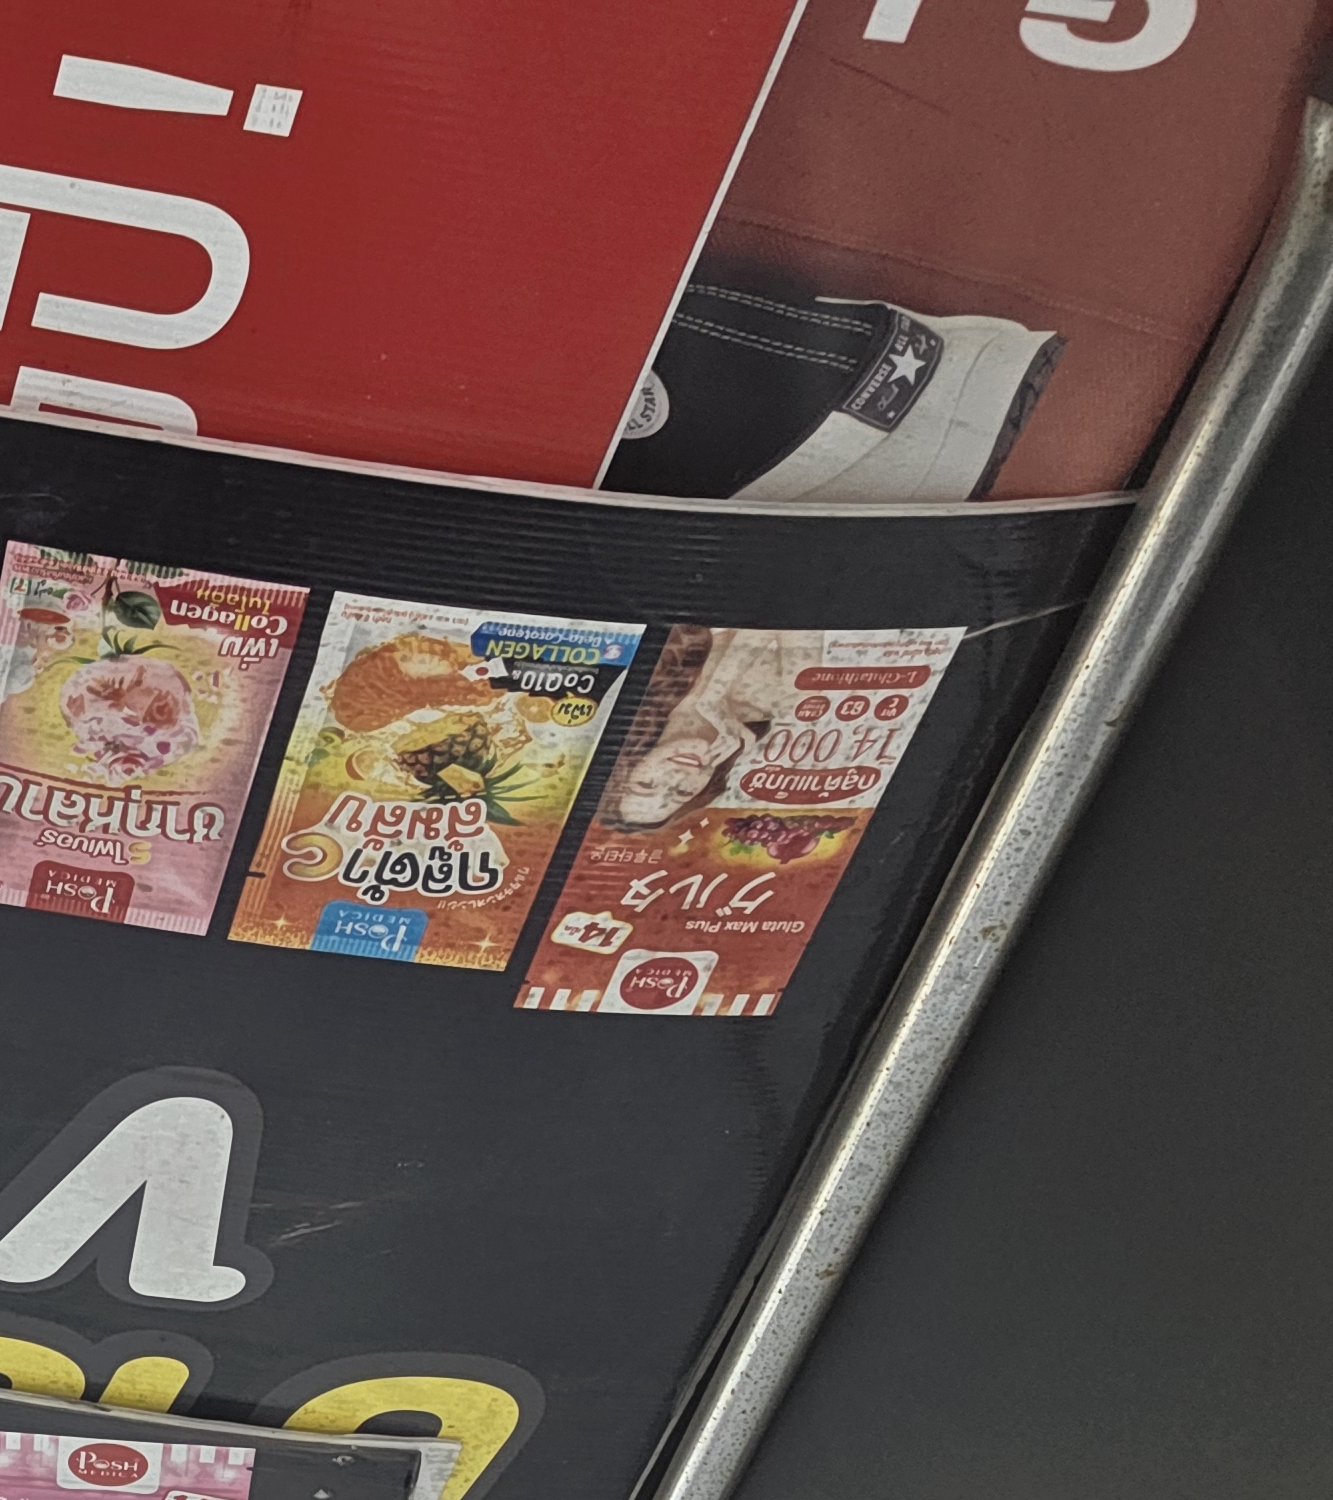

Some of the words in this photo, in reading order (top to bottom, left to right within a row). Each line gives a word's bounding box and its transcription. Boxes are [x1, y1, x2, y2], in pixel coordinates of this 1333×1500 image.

[169, 598, 287, 635] Collagen
[219, 634, 279, 669] เพิ่ม
[483, 638, 600, 664] COLLAGEN
[519, 669, 595, 693] CoQ10
[811, 669, 918, 684] L-Glutathione
[556, 701, 593, 724] เพิ่ม
[839, 699, 864, 715] B3
[761, 723, 901, 763] 14,000
[35, 828, 126, 863] ไฟเบอร์
[282, 831, 342, 879] C
[47, 867, 116, 887] MEDICA
[341, 846, 498, 902] กลูต้า
[619, 867, 777, 917] グルタ
[337, 908, 410, 925] MEDICA
[683, 918, 722, 933] Plus
[724, 919, 758, 932] Max
[760, 918, 805, 933] Gluta
[581, 920, 619, 948] 14
[632, 966, 692, 977] MEDICA
[78, 1468, 140, 1479] MEDICA
